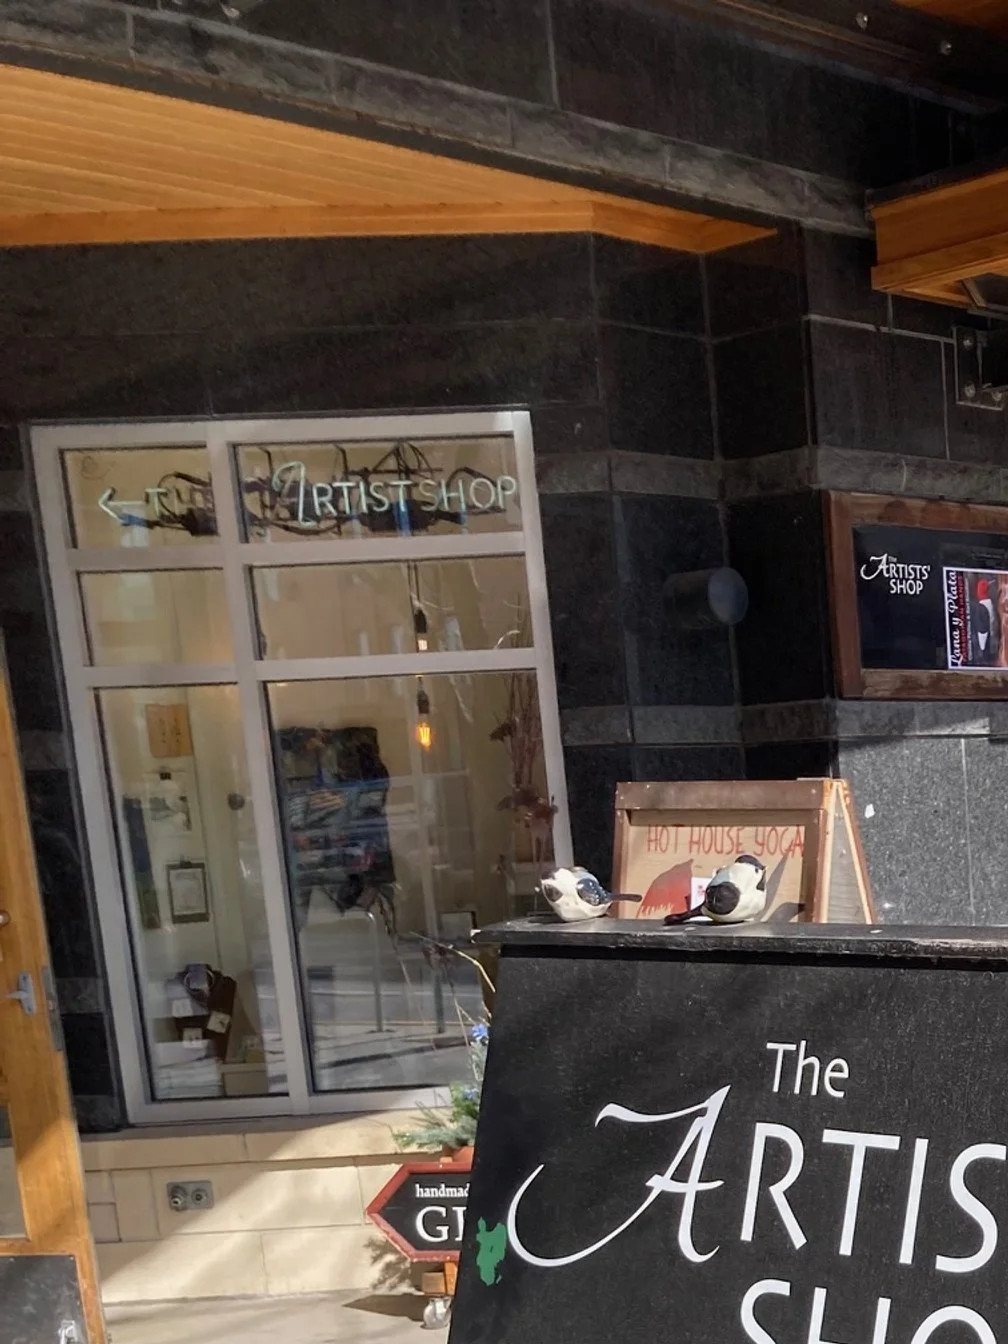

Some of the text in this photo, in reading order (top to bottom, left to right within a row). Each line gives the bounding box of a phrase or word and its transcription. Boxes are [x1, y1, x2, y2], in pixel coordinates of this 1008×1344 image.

[272, 460, 412, 528] ARTIST
[417, 474, 517, 513] SHOP
[860, 553, 931, 580] ARTISTS'
[889, 578, 924, 595] SHOP
[947, 570, 964, 667] Lana y Plata
[647, 824, 804, 858] HOT HOUSE YOGA
[766, 1041, 849, 1099] The
[415, 1183, 470, 1198] handmad
[415, 1205, 467, 1243] GI
